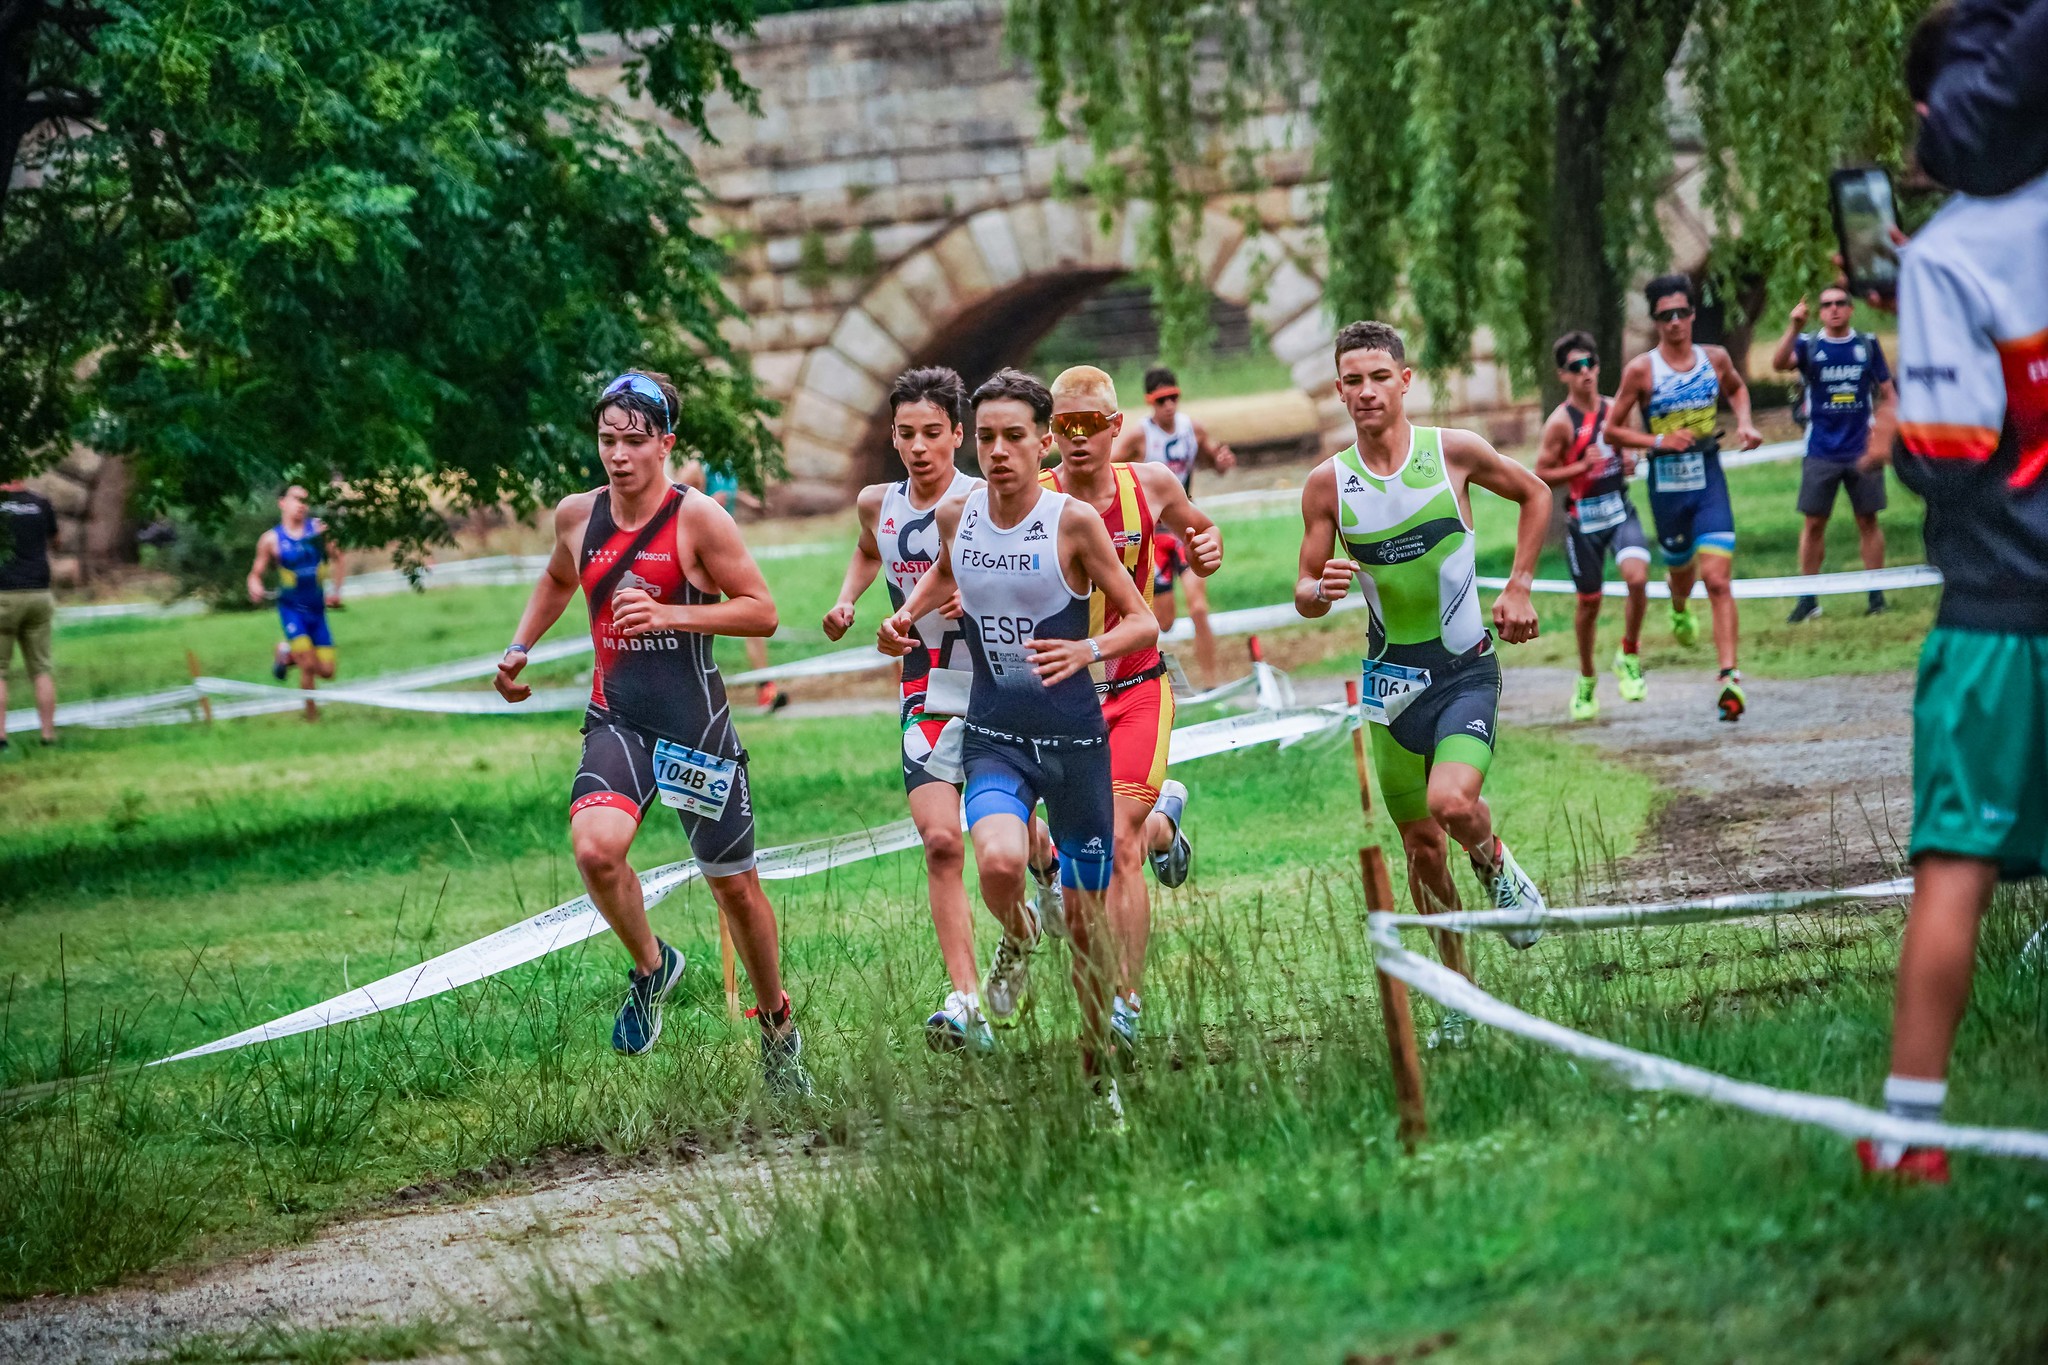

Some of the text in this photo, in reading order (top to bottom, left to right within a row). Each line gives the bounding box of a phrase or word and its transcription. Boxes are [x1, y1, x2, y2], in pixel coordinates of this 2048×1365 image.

[635, 550, 672, 562] Mosconi
[980, 615, 1034, 645] ESP
[602, 637, 680, 651] MADRID
[657, 759, 707, 790] 104B
